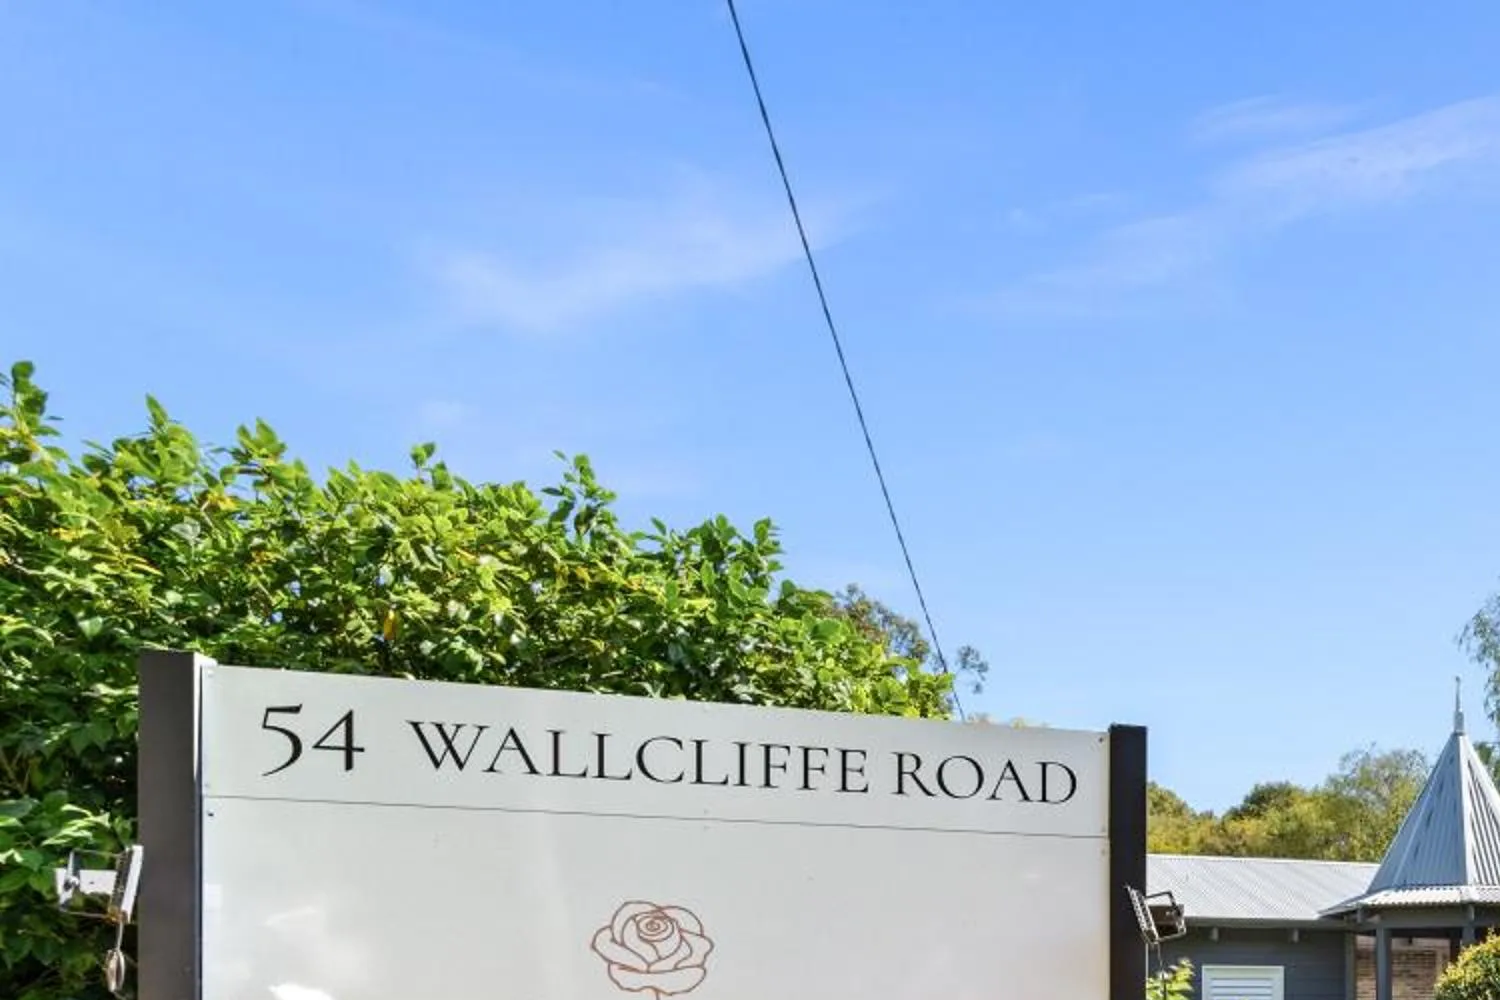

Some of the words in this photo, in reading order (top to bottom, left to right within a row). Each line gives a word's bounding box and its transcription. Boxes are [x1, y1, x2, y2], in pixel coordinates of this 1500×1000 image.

[260, 702, 367, 778] 54
[405, 718, 870, 795] WALLCLIFFE
[891, 750, 1079, 806] ROAD
